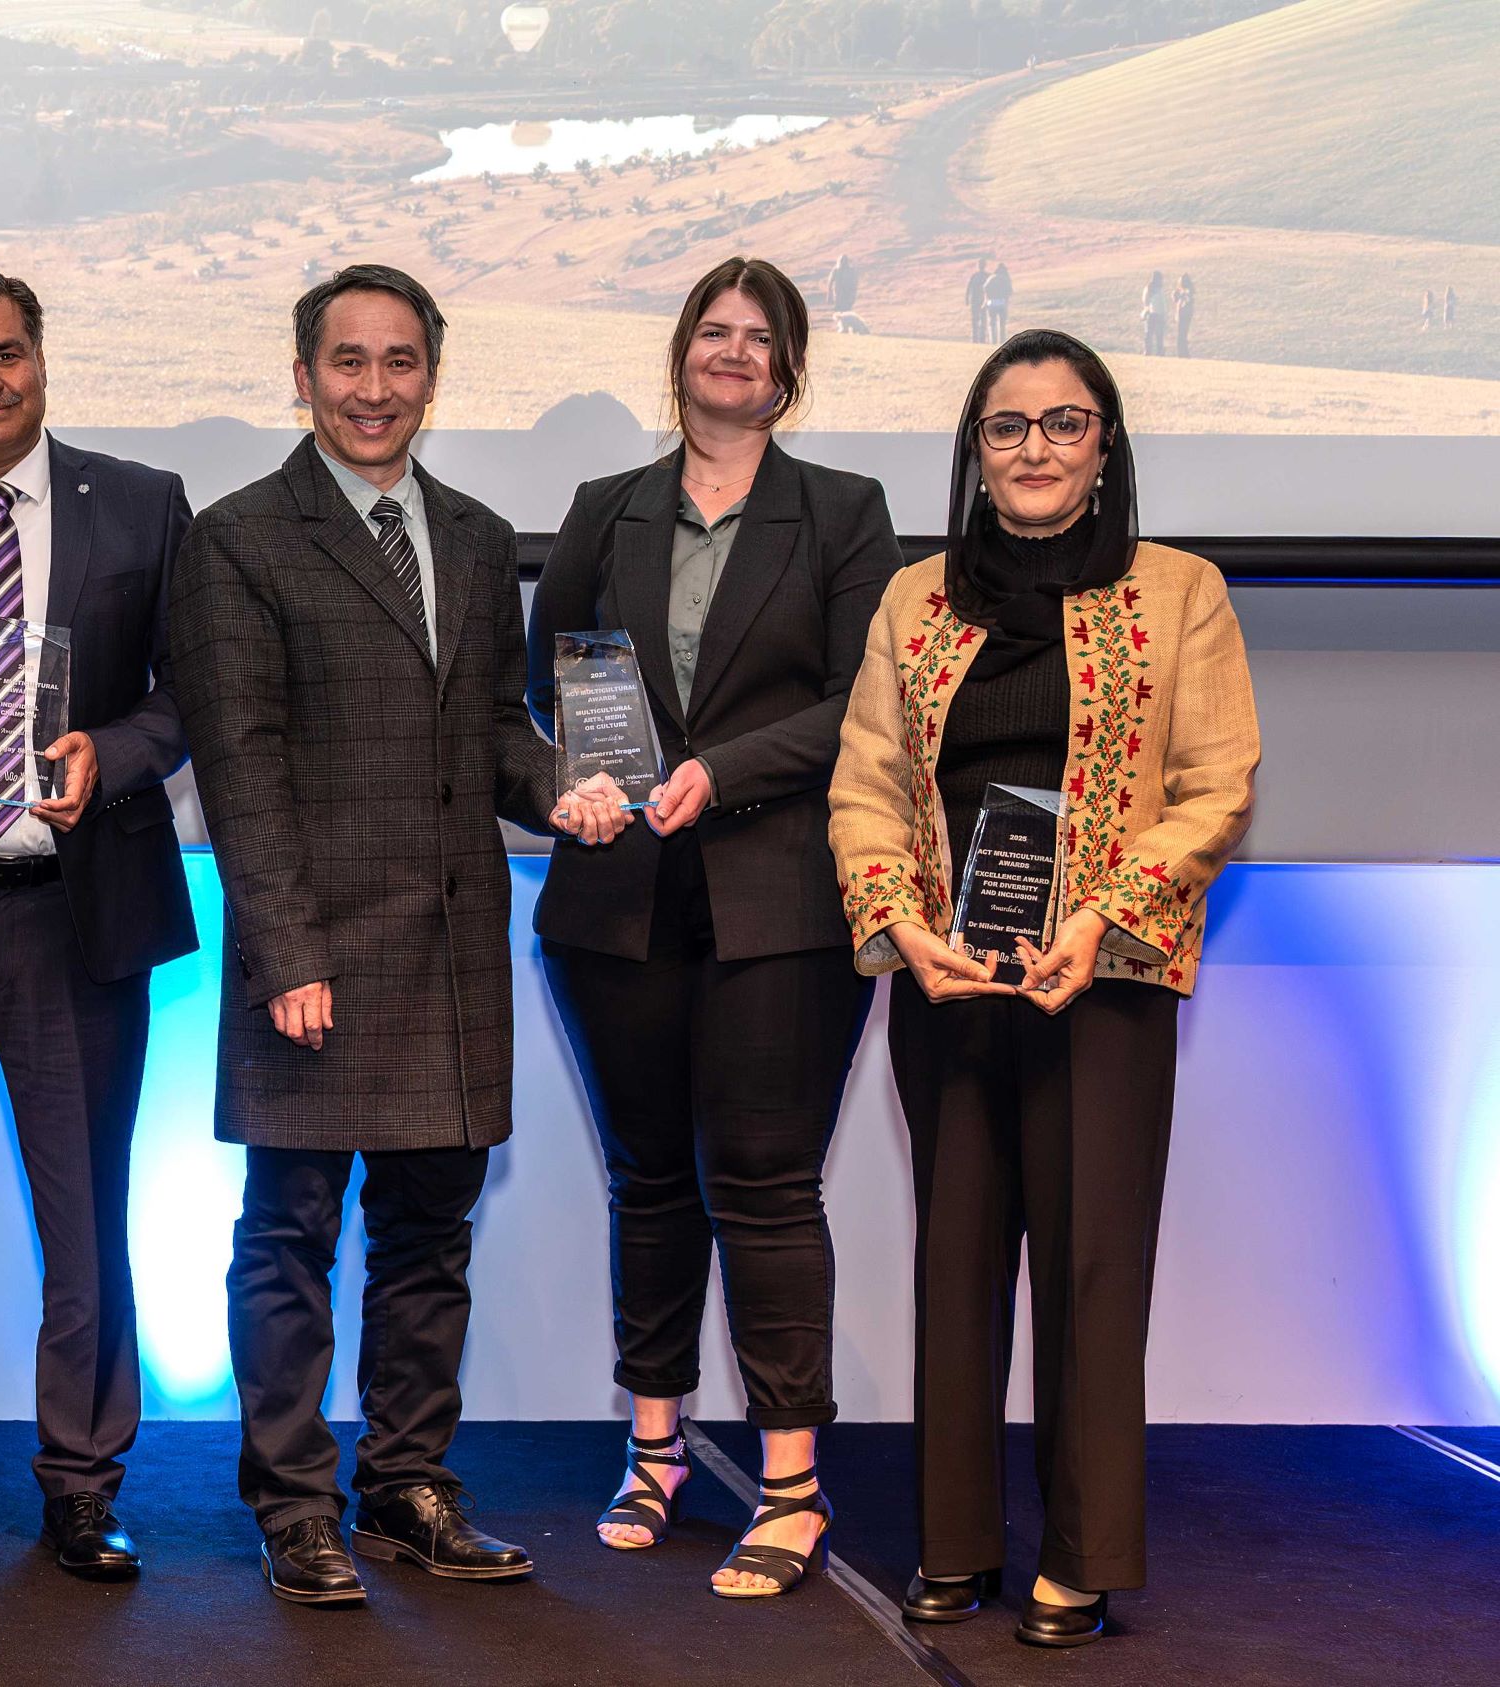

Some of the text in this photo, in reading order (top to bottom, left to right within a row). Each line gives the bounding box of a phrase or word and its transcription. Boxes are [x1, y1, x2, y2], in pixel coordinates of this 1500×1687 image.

[580, 684, 637, 696] MULTICULTURAL
[588, 695, 617, 703] AWARDS
[575, 705, 633, 716] MULTICULTURAL
[604, 713, 627, 721] MEDIA
[596, 721, 628, 730] CULTURE
[580, 747, 641, 759] Canberra Dragon
[600, 758, 623, 766] Dance
[1009, 834, 1028, 842] 2025
[993, 850, 1054, 863] MULTICULTURAL
[998, 860, 1030, 869] AWARDS
[975, 870, 1050, 885] EXCELLENCE AWARD
[999, 882, 1039, 892] DIVERSITY
[981, 888, 1038, 901] AND INCLUSION
[990, 903, 1017, 913] Awarded
[968, 920, 977, 928] Dr
[1005, 925, 1040, 936] Ebrahimi
